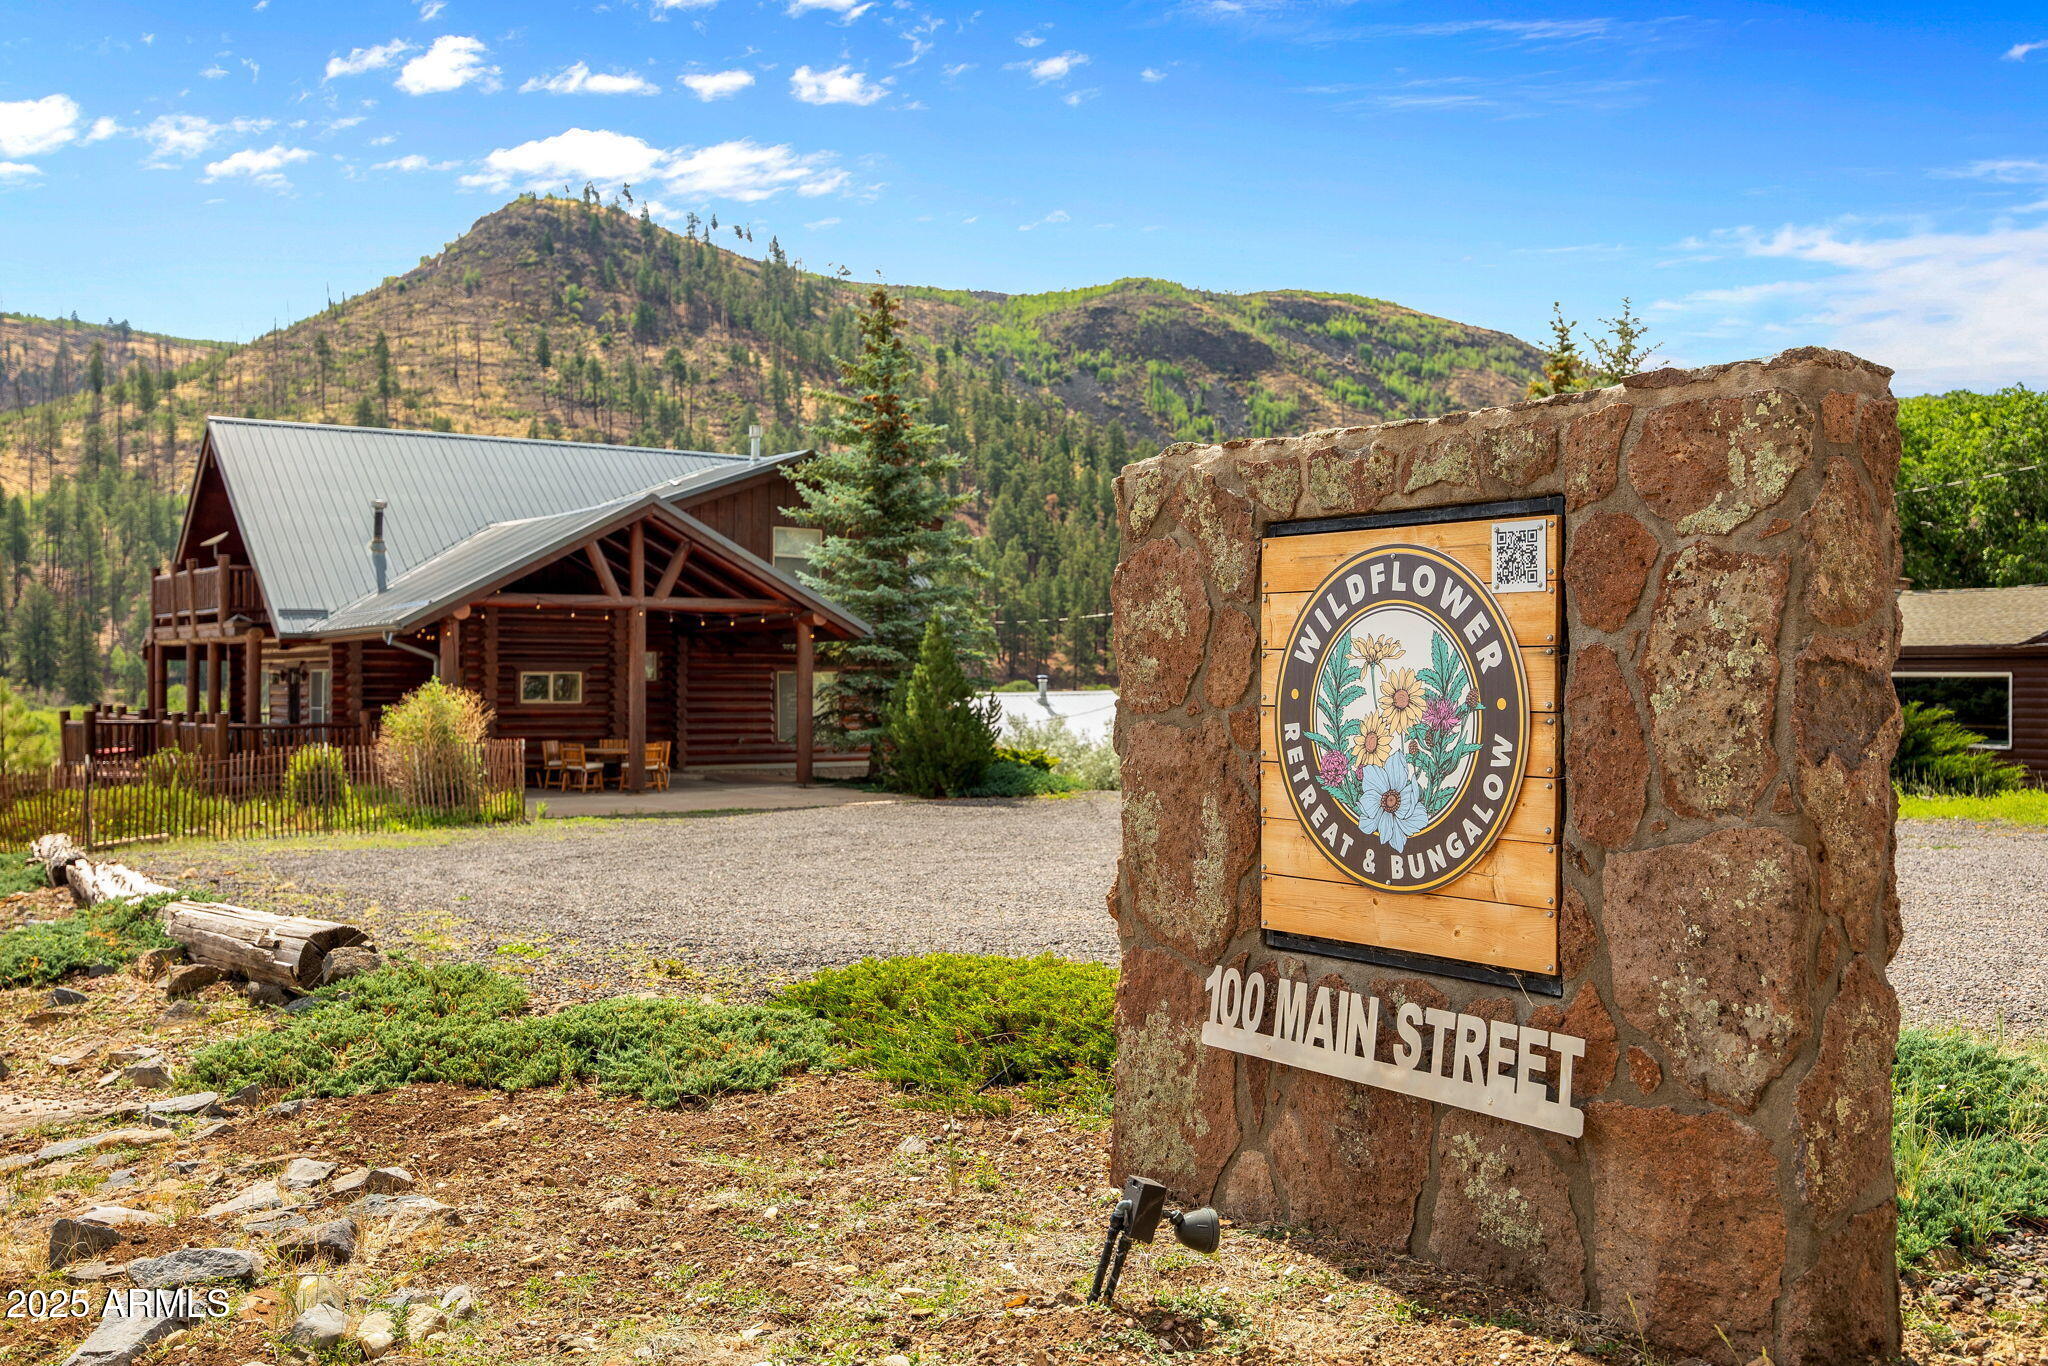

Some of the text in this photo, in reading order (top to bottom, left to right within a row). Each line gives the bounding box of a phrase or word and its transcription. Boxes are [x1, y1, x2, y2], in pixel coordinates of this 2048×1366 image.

[1293, 561, 1503, 674] WILDFLOWER
[1283, 722, 1513, 880] RETREAT & BUNGALOW
[1205, 964, 1586, 1109] 100 MAIN STREET
